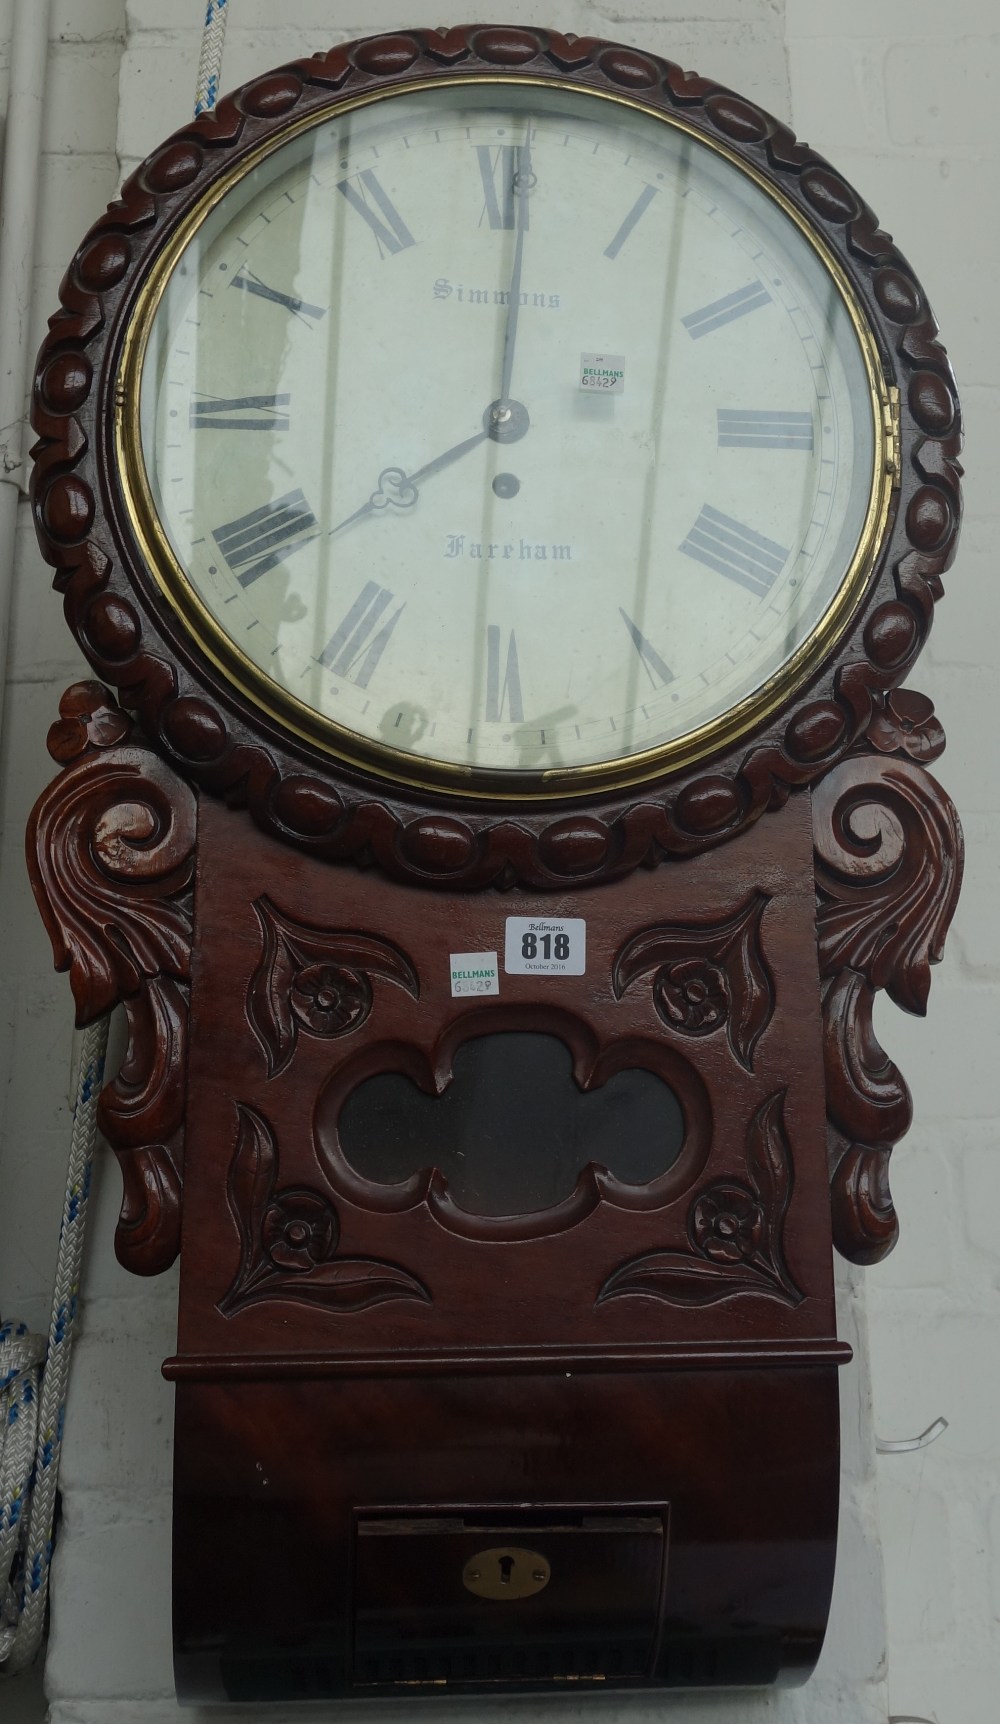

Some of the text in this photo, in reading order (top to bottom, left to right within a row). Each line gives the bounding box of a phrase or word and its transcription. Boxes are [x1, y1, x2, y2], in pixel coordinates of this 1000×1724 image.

[432, 278, 561, 308] Simmons
[583, 367, 624, 378] BELLMANS
[443, 534, 573, 560] Fareham
[528, 922, 564, 932] Bellmans
[521, 932, 570, 960] 818
[452, 969, 495, 979] BELLMANS
